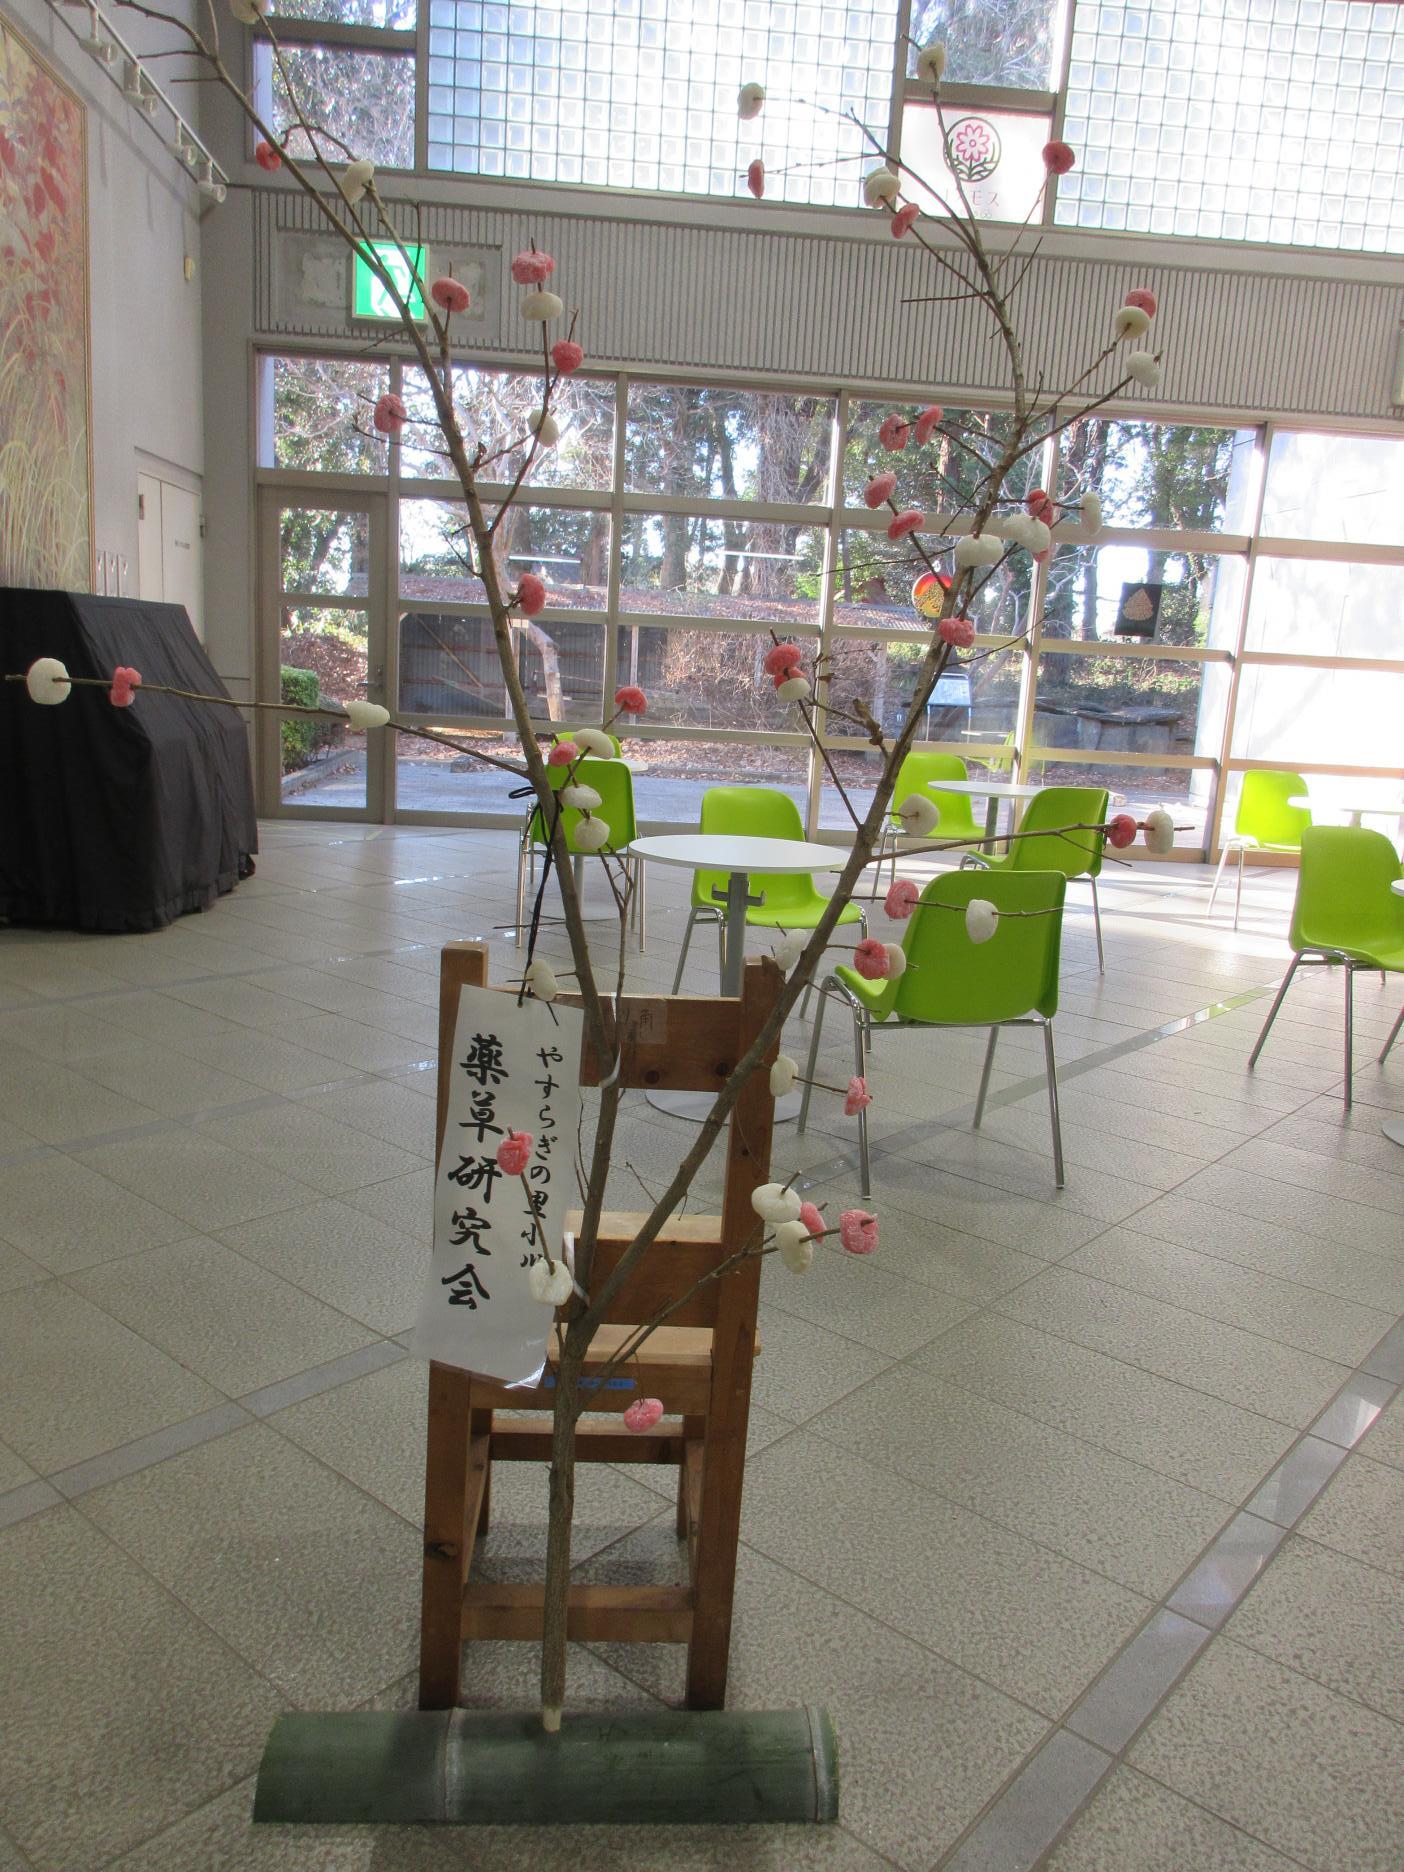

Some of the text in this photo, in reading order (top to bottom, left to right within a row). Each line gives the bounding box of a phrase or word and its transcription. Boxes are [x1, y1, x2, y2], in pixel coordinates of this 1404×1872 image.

[441, 1032, 509, 1310] 薬草研究会
